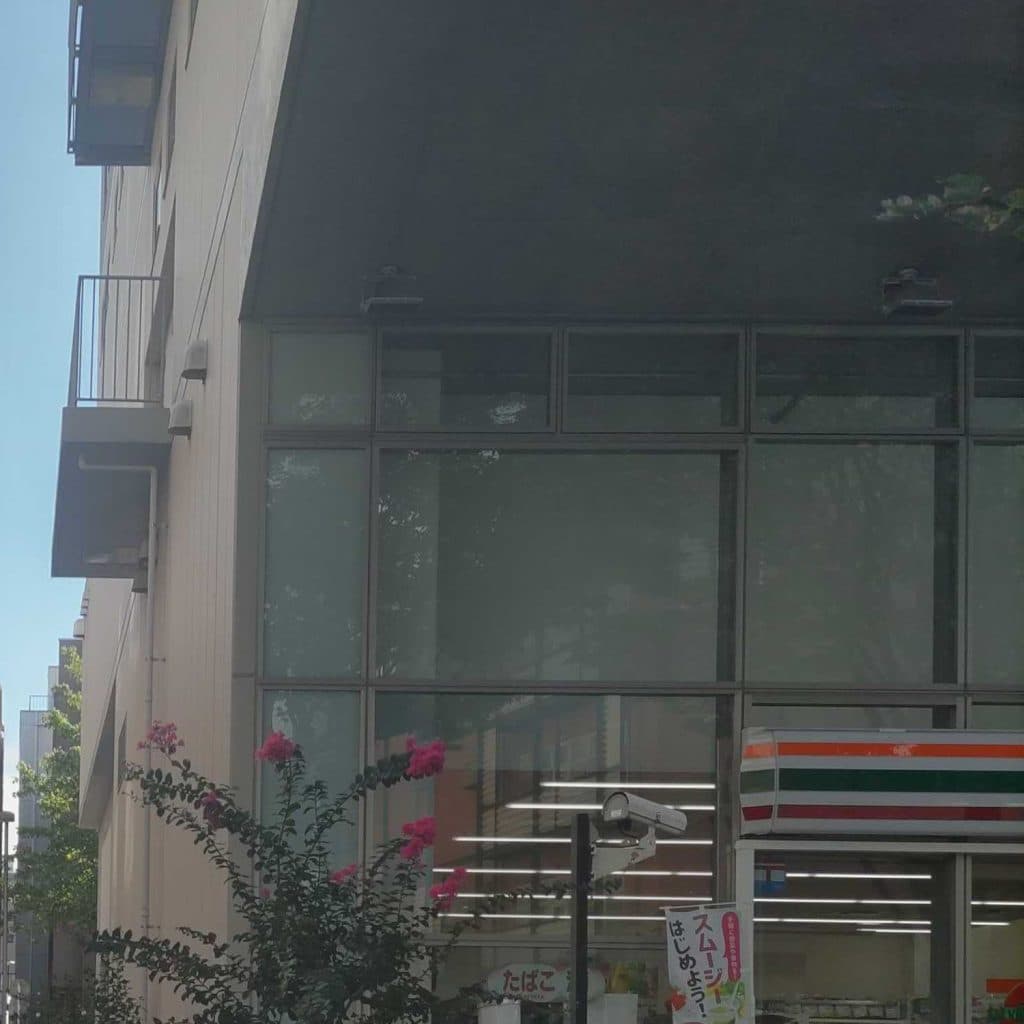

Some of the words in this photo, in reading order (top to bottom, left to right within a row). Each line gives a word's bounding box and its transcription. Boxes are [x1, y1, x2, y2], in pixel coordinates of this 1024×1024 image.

[502, 969, 555, 993] たばこ
[692, 913, 722, 1004] スムージー
